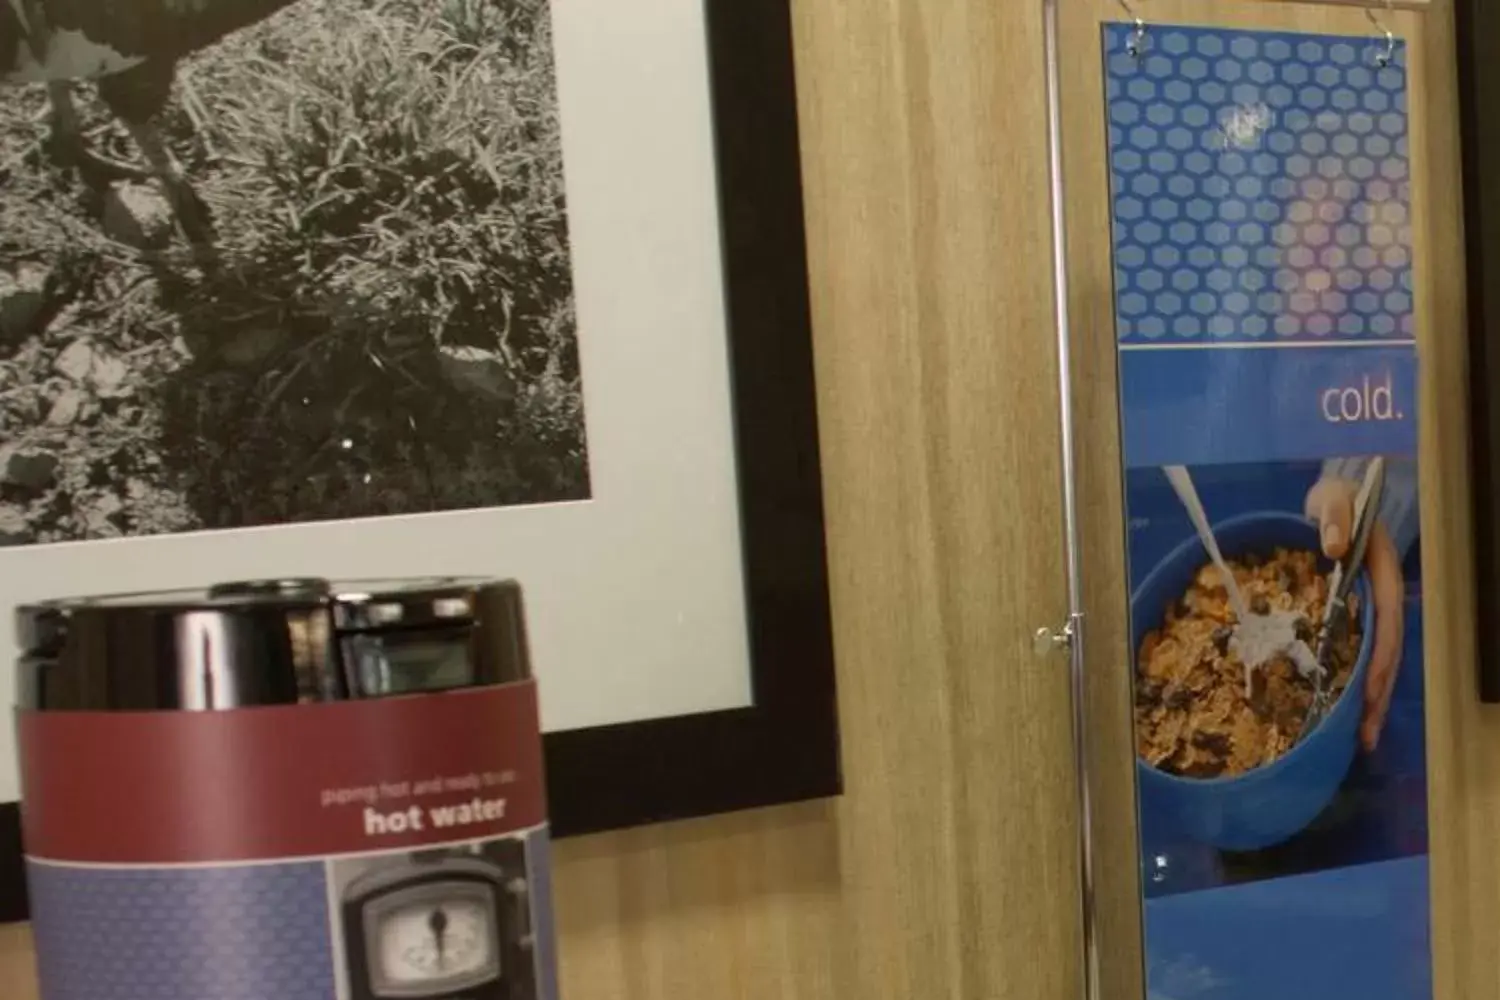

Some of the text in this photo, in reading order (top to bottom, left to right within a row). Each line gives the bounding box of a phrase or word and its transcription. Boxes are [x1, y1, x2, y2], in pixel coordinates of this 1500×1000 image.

[1322, 371, 1403, 421] cold.
[363, 797, 508, 836] hot water
